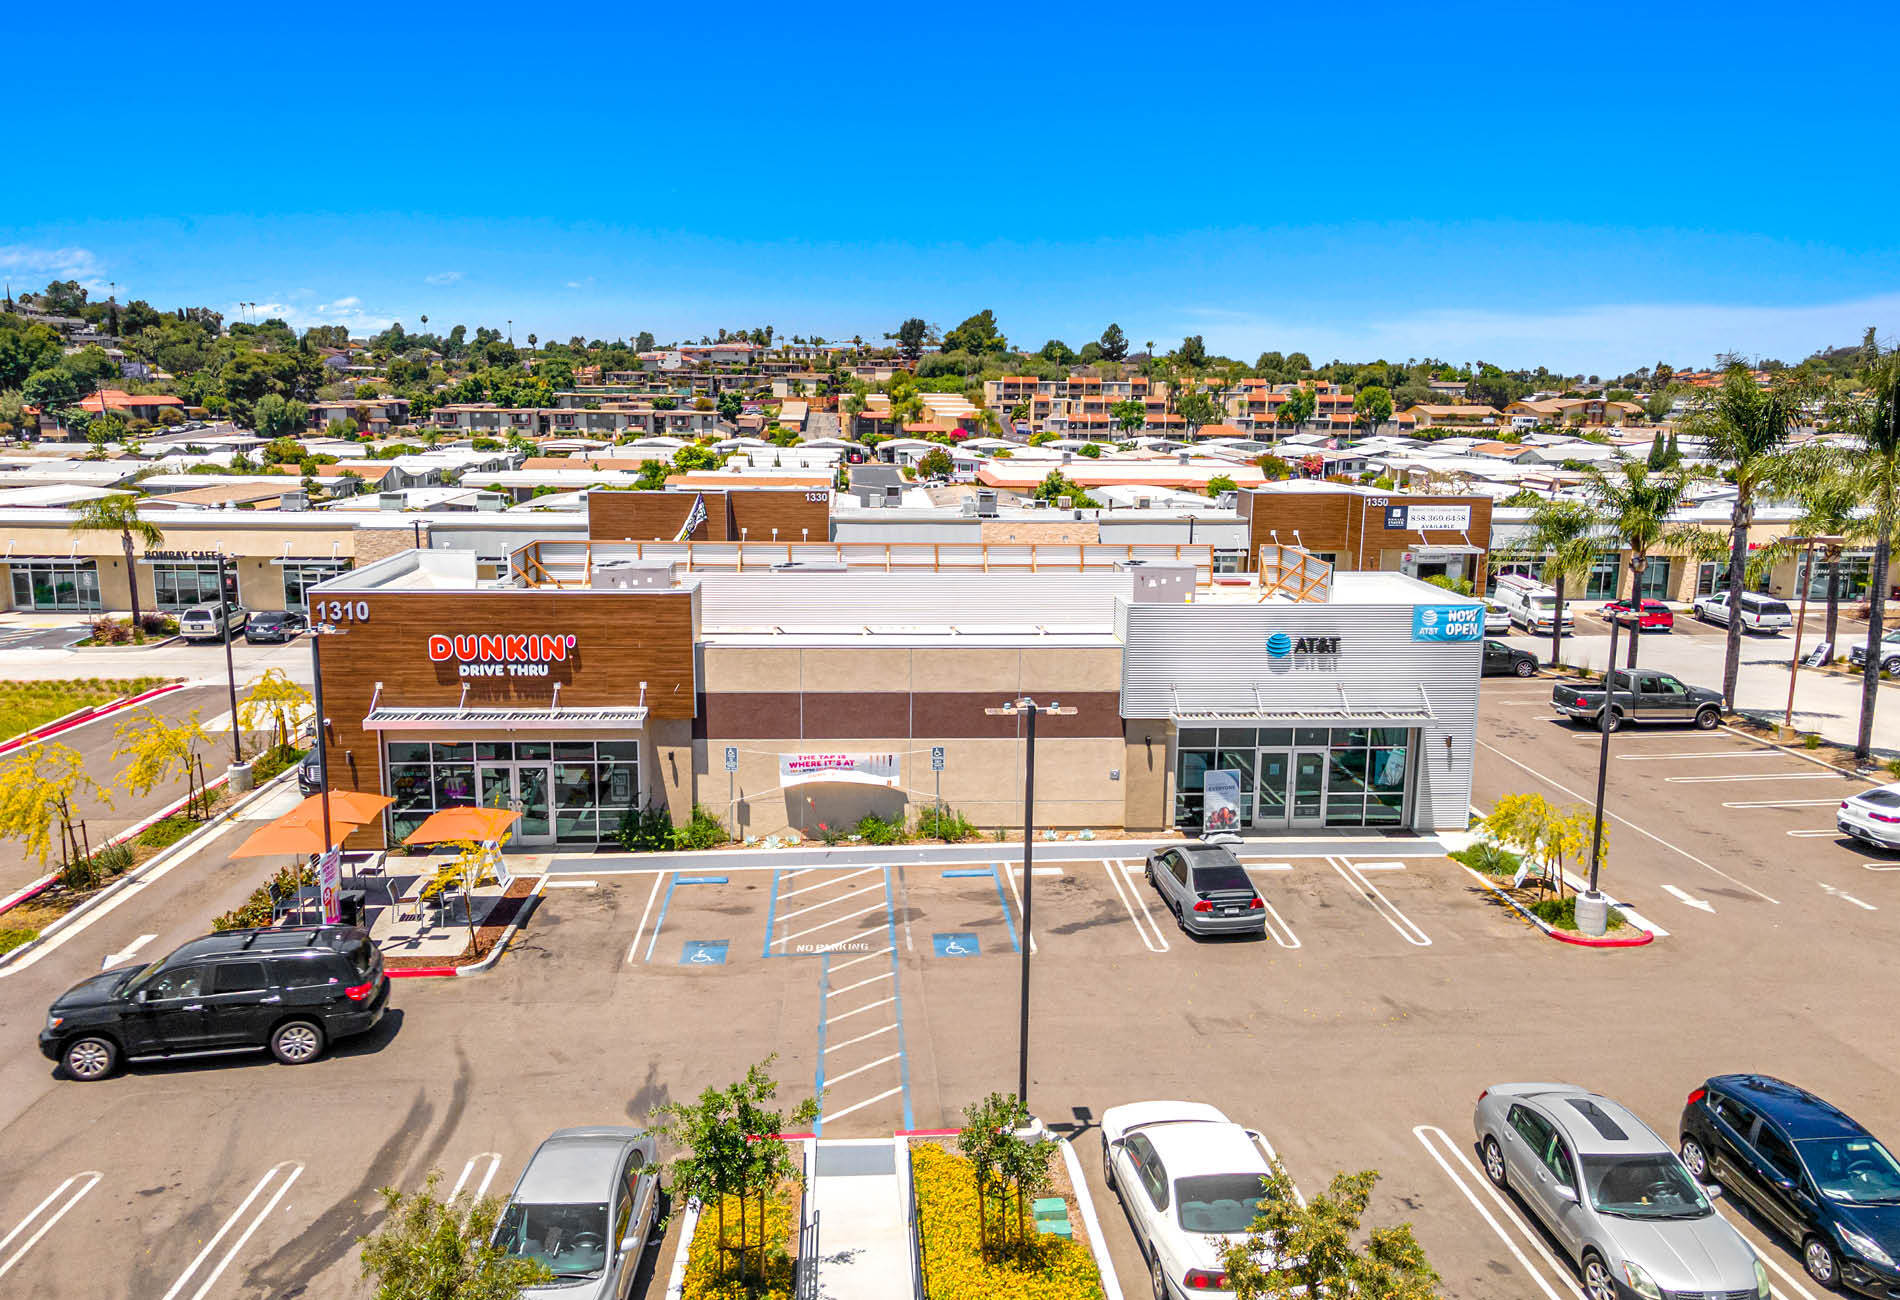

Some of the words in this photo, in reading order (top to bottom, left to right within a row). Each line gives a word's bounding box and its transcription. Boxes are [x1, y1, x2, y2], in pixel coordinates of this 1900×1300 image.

[804, 493, 828, 502] 1330
[1366, 498, 1388, 506] 1350
[144, 551, 188, 560] BOMBAY
[316, 601, 370, 622] 1310
[1448, 609, 1478, 622] NOW
[1419, 627, 1439, 635] AT&T
[1445, 623, 1478, 636] OPEN
[428, 634, 577, 662] DUNKIN'
[1294, 637, 1342, 654] AT&T
[458, 664, 505, 677] DRIVE
[508, 664, 549, 677] THRU
[788, 761, 822, 769] WHERE
[796, 944, 814, 953] NO
[815, 943, 869, 952] PARKING
